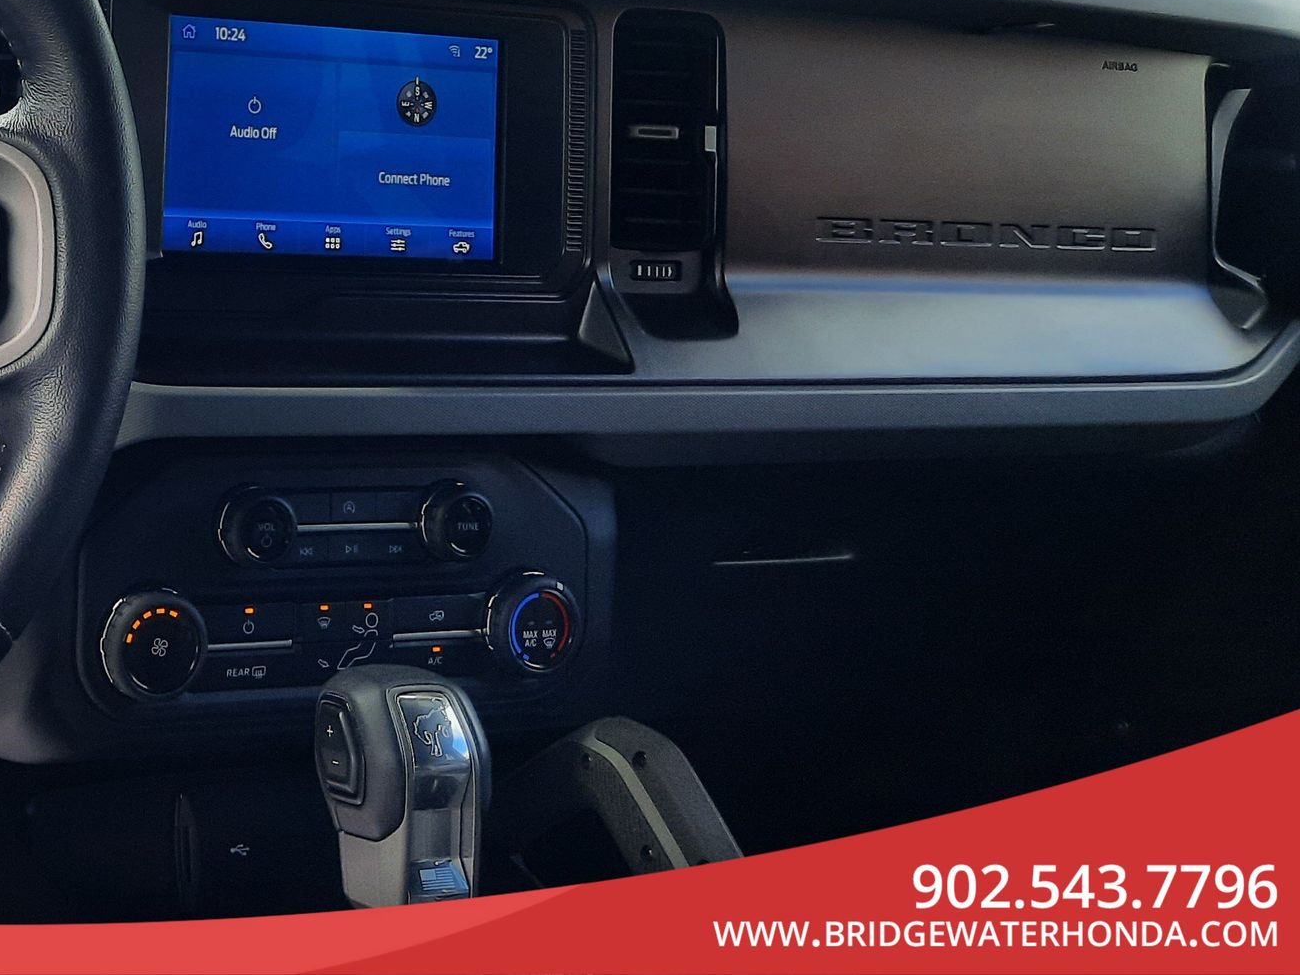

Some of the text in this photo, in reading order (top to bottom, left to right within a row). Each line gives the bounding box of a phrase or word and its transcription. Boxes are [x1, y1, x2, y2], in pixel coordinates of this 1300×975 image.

[215, 27, 246, 42] 10:24
[1101, 59, 1138, 73] AIRBAG
[230, 124, 278, 140] Audio Off
[378, 171, 451, 188] Connect Phone
[188, 220, 207, 229] Audio
[256, 222, 276, 232] Phone
[325, 225, 341, 235] Apps
[385, 227, 412, 238] Settings
[448, 228, 475, 238] Features
[816, 215, 1157, 252] BRONCO
[258, 523, 275, 532] VOL
[458, 522, 480, 532] TUNE
[523, 630, 538, 639] MAX
[542, 628, 557, 638] MAX
[525, 638, 537, 647] A/C
[428, 656, 443, 665] A/C
[226, 668, 251, 678] REAR
